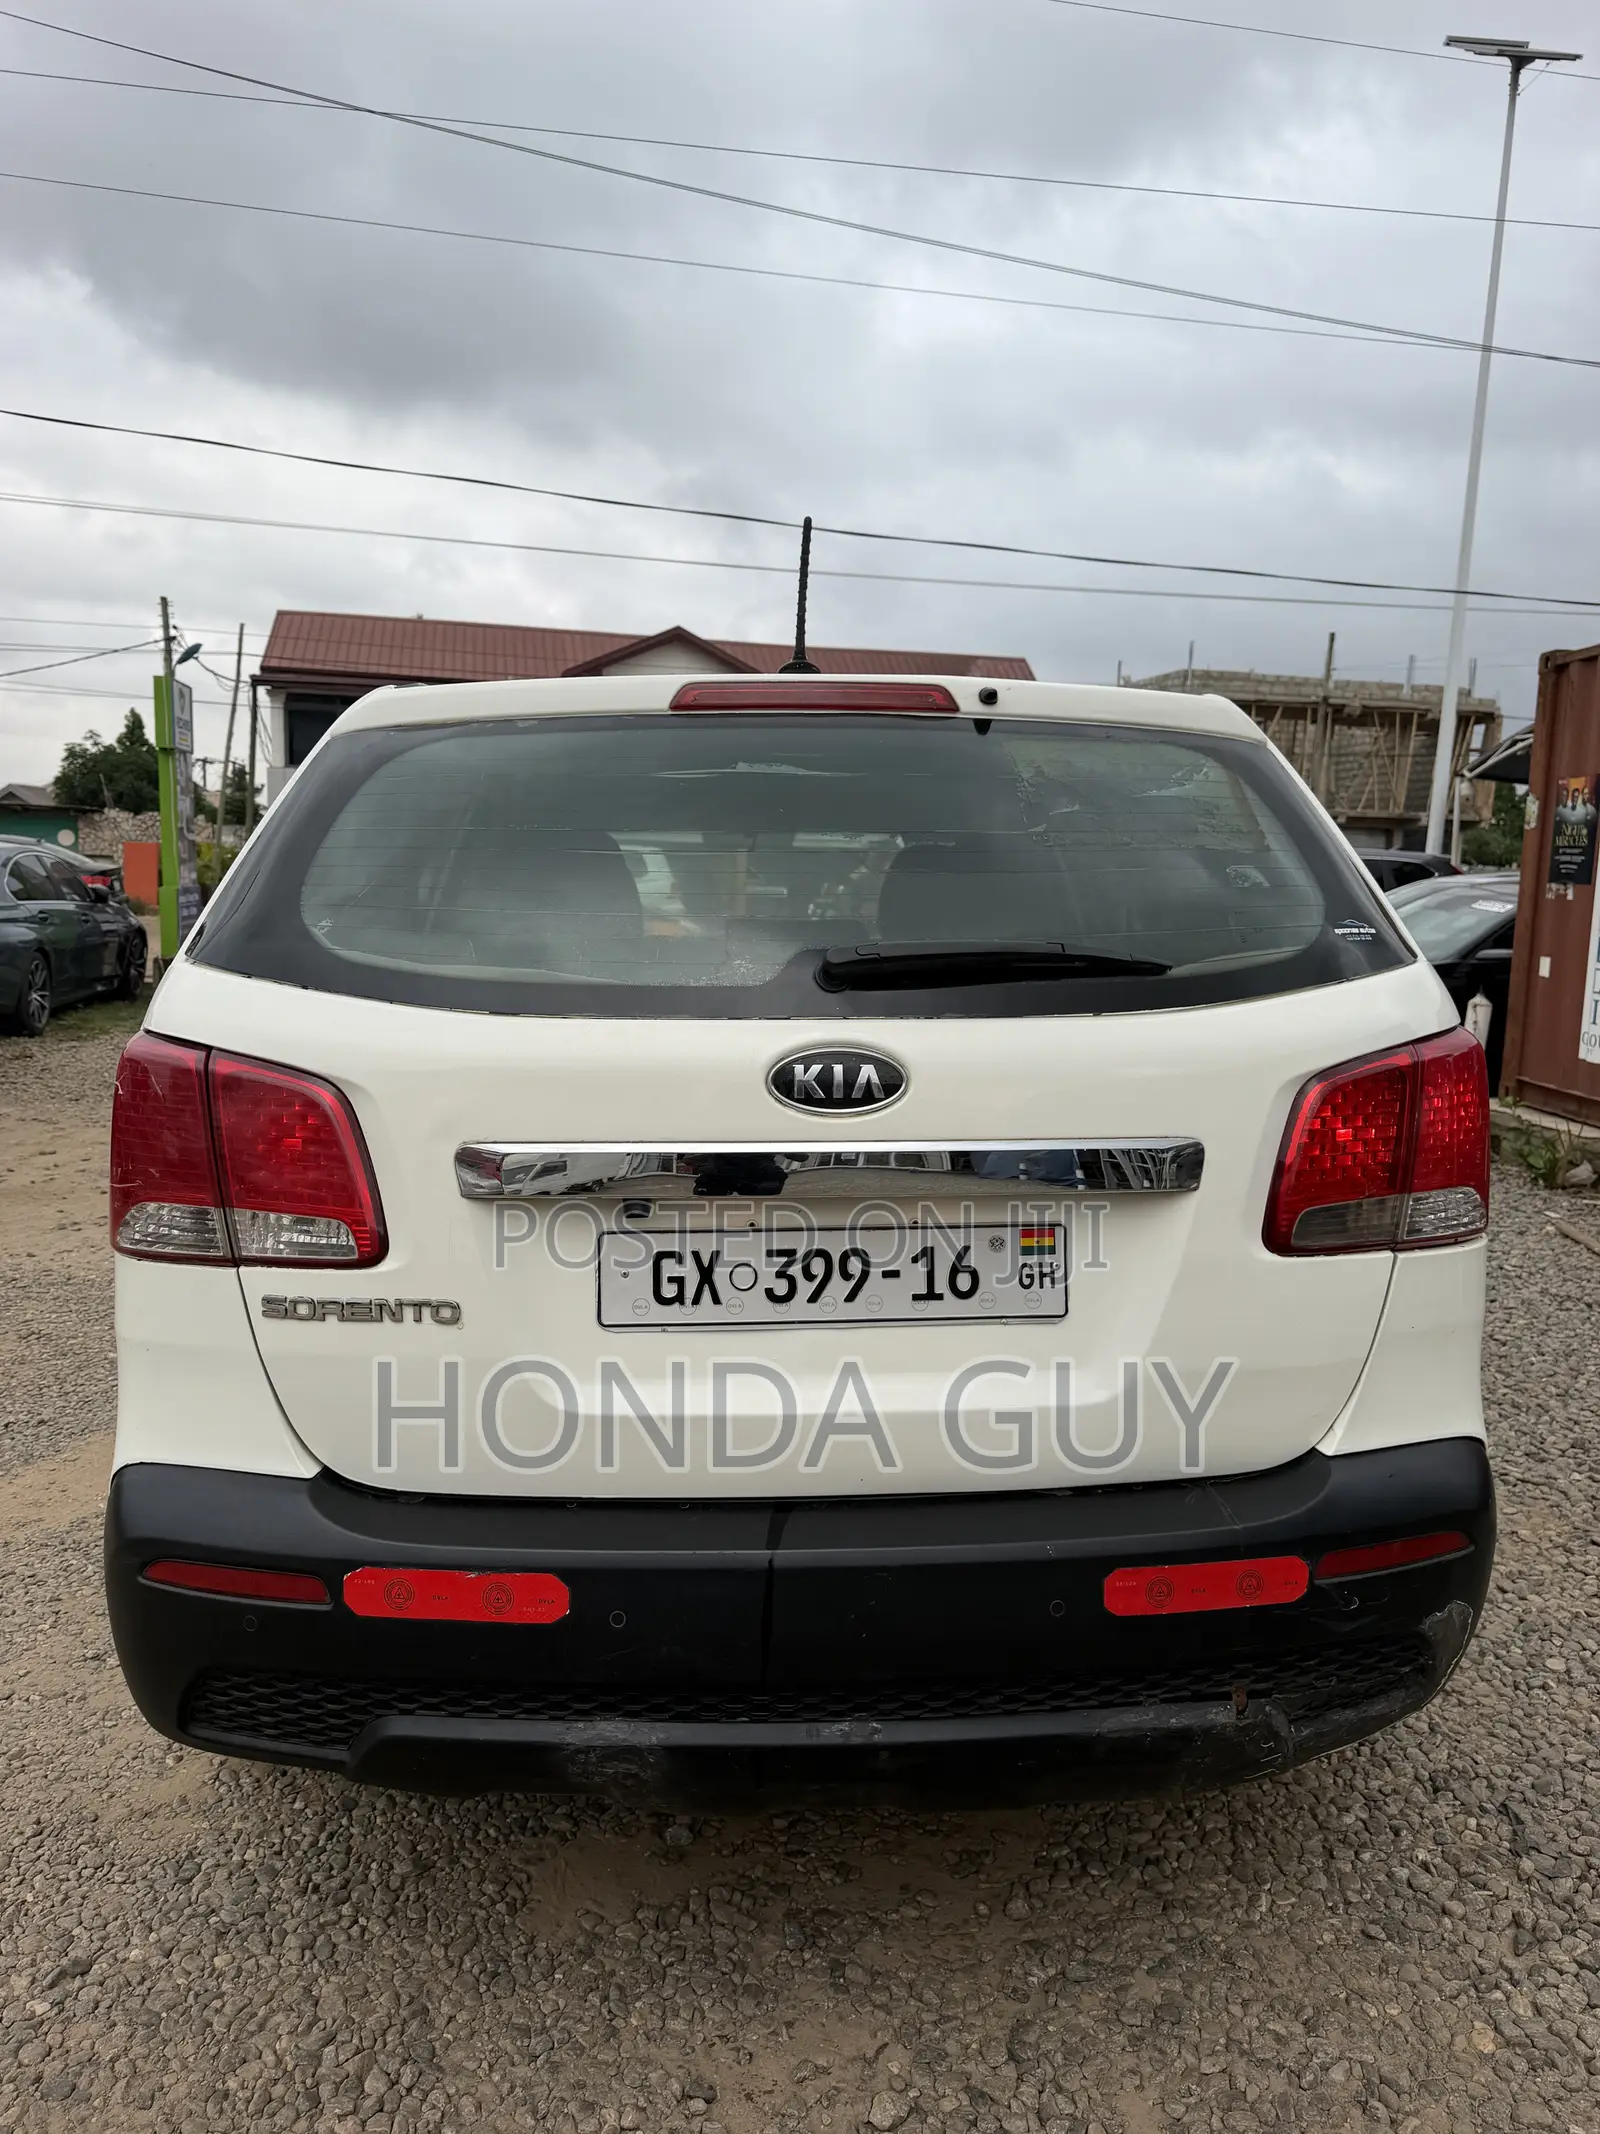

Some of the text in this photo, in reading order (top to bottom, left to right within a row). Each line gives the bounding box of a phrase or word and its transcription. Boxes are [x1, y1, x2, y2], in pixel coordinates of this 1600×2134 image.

[792, 1064, 886, 1099] KIA
[651, 1244, 980, 1306] GX 399-16
[1018, 1262, 1057, 1291] GH
[261, 1293, 461, 1325] SORENTO
